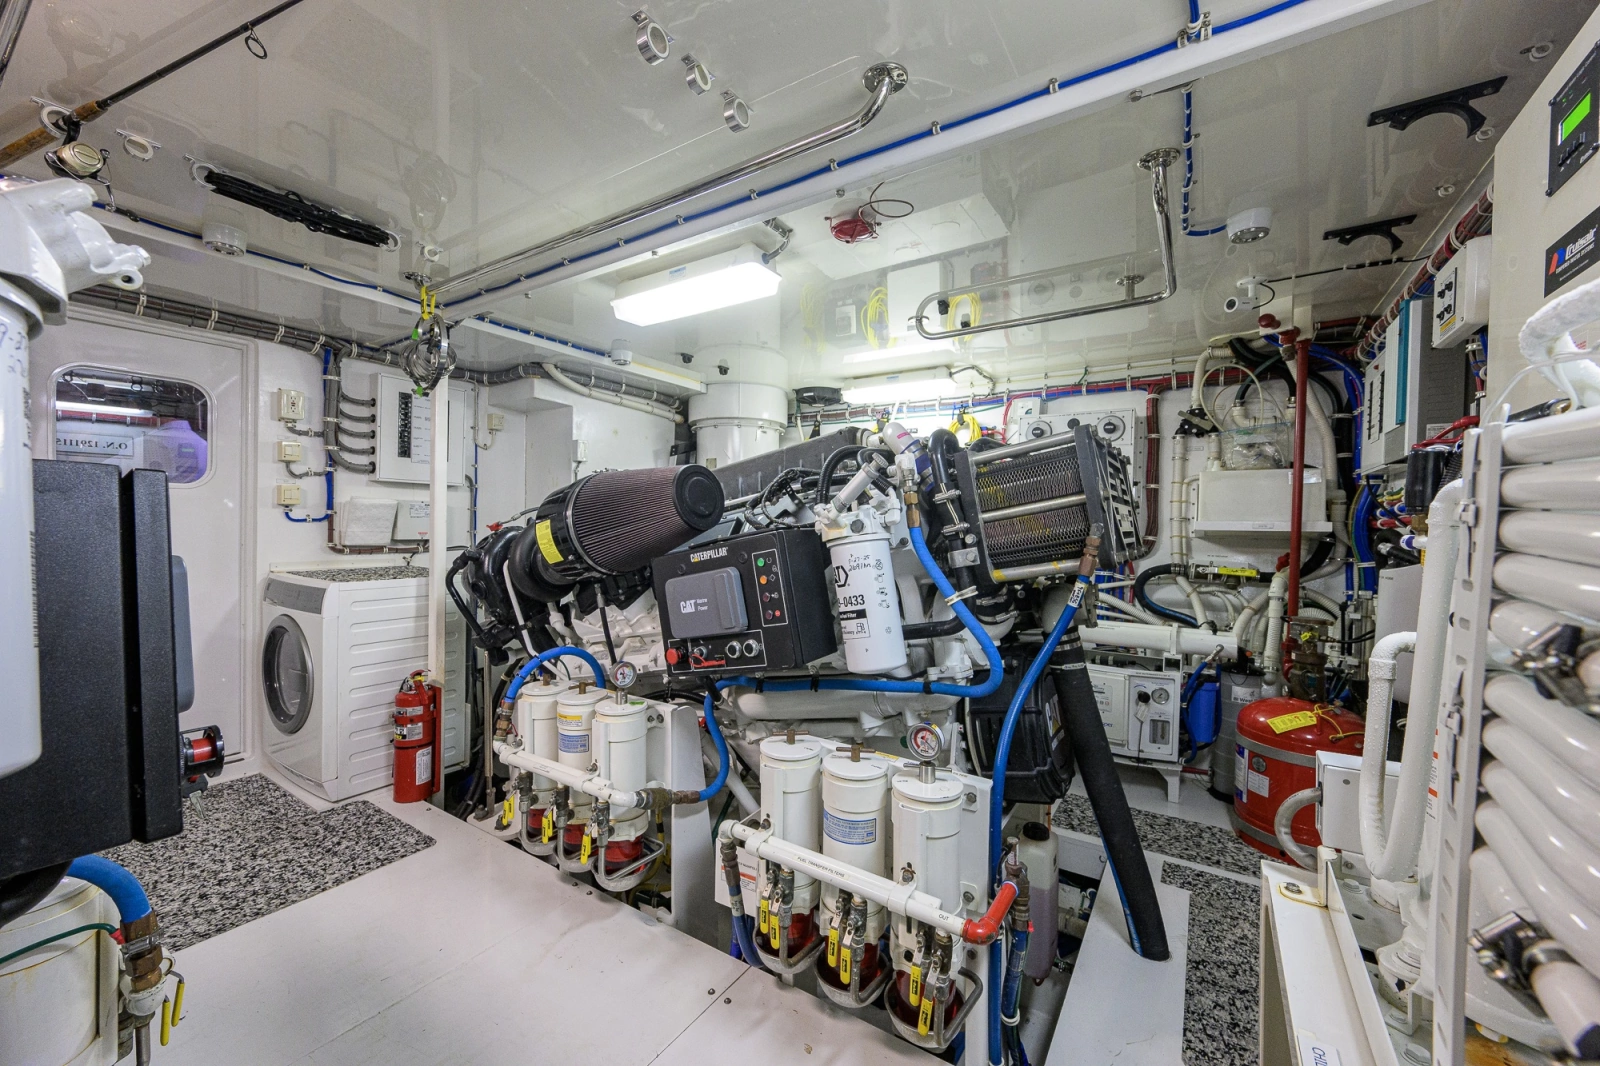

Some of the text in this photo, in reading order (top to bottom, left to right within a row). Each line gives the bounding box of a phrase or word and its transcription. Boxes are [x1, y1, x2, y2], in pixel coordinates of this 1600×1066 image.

[690, 547, 729, 563] CATERPILLAR
[680, 599, 696, 614] CAT
[938, 912, 950, 922] OUT
